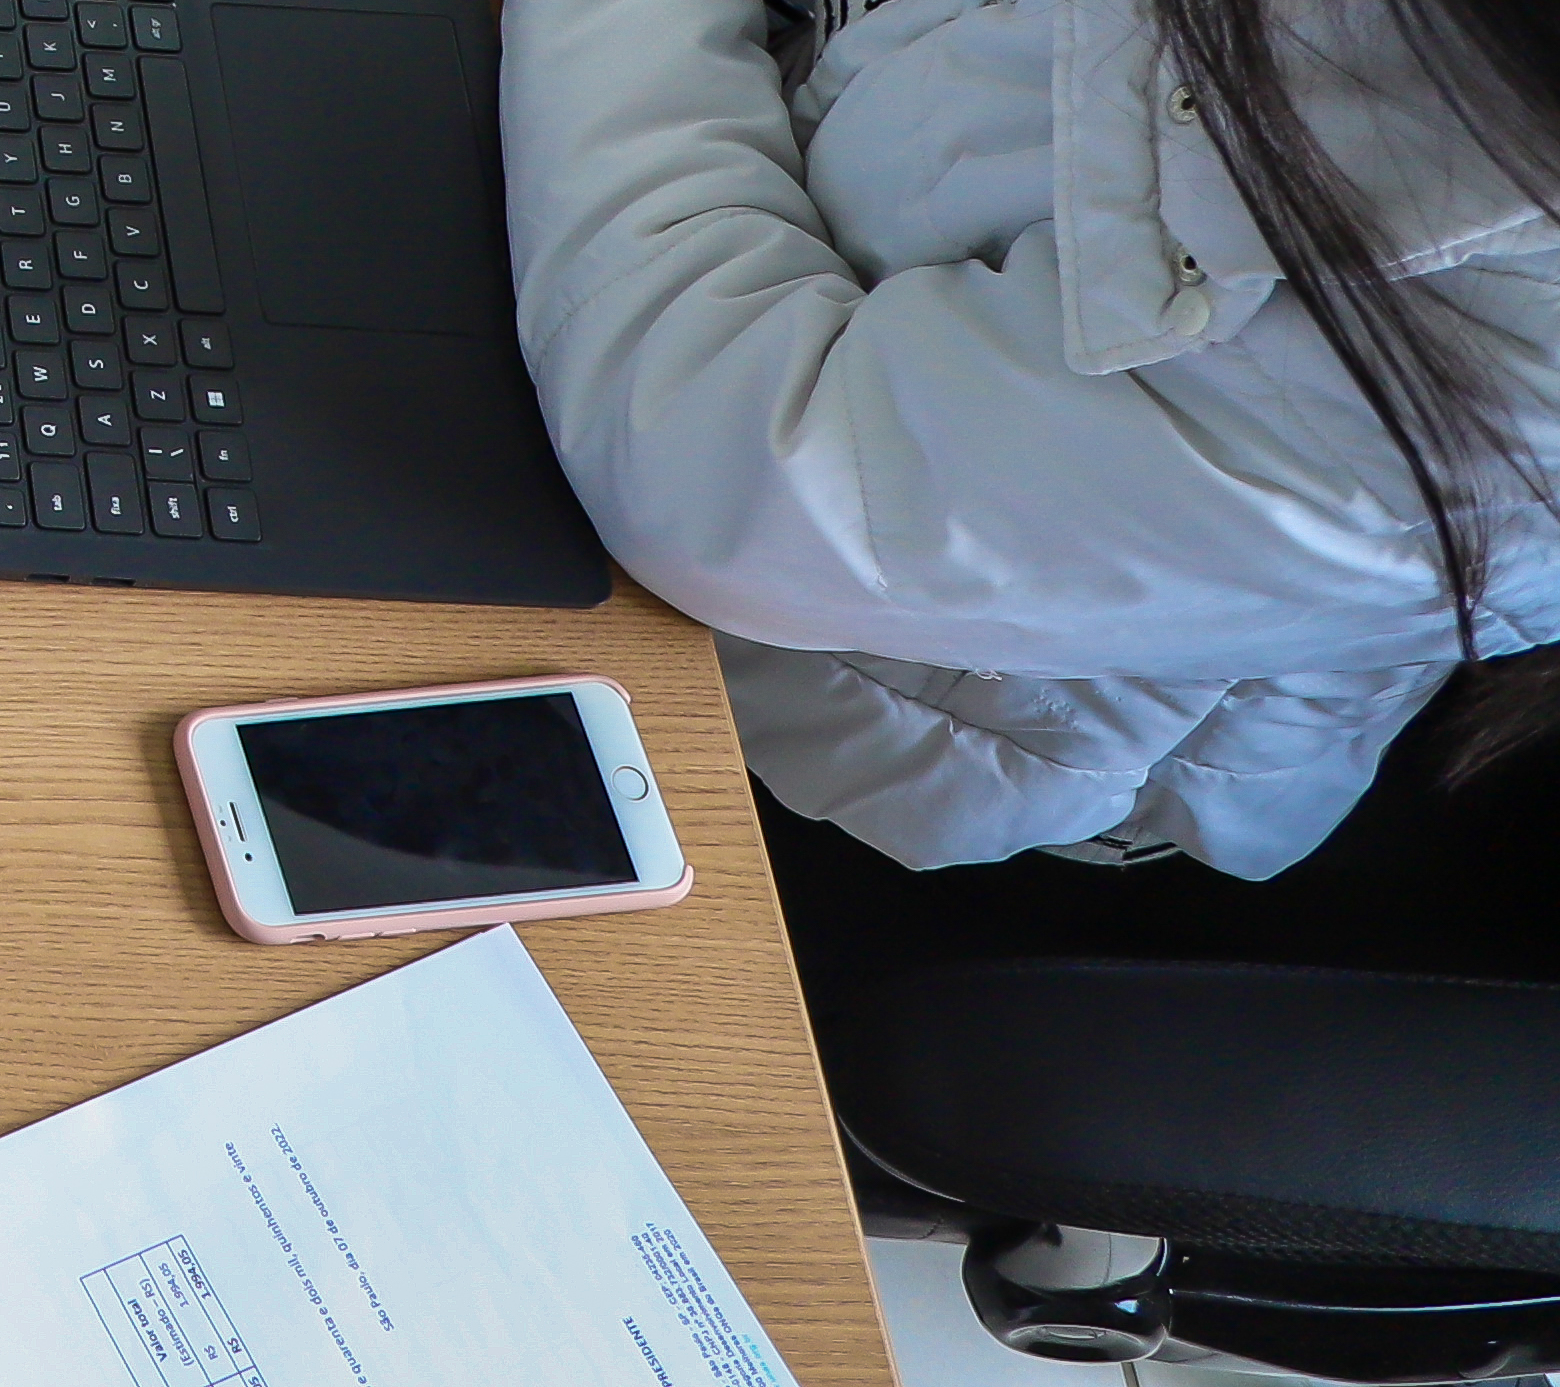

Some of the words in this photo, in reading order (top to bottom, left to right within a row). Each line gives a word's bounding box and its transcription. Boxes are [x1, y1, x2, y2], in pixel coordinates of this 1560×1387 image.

[43, 42, 57, 51] K
[102, 68, 116, 82] M
[50, 93, 65, 101] J
[110, 121, 125, 132] N
[58, 143, 73, 154] H
[4, 153, 18, 163] Y
[118, 174, 132, 183] B
[65, 196, 80, 207] G
[11, 206, 26, 216] T
[126, 225, 140, 236] V
[73, 250, 88, 260] F
[18, 259, 33, 270] R
[133, 280, 149, 290] C
[81, 303, 96, 315] D
[25, 314, 41, 324] E
[142, 334, 158, 346] X
[88, 359, 104, 369] S
[33, 366, 48, 382] W
[150, 390, 166, 401] Z
[97, 414, 112, 426] A
[40, 424, 56, 437] Q
[224, 1141, 247, 1173] vinte
[289, 1156, 302, 1171] de
[244, 1174, 253, 1183] e
[299, 1173, 329, 1218] outubro
[248, 1183, 295, 1254] quinhentos
[326, 1219, 339, 1234] de
[336, 1236, 349, 1251] 07
[344, 1253, 360, 1271] dia
[179, 1249, 212, 1300] 1.994,05
[159, 1262, 191, 1308] 1.994,05
[356, 1272, 382, 1308] Paulo,
[302, 1279, 323, 1306] dois
[129, 1299, 149, 1327] total
[319, 1306, 328, 1316] e
[377, 1310, 394, 1331] São
[157, 1309, 194, 1366] (Estimado
[146, 1328, 168, 1361] Valor
[325, 1316, 364, 1374] quarenta
[359, 1376, 367, 1384] e
